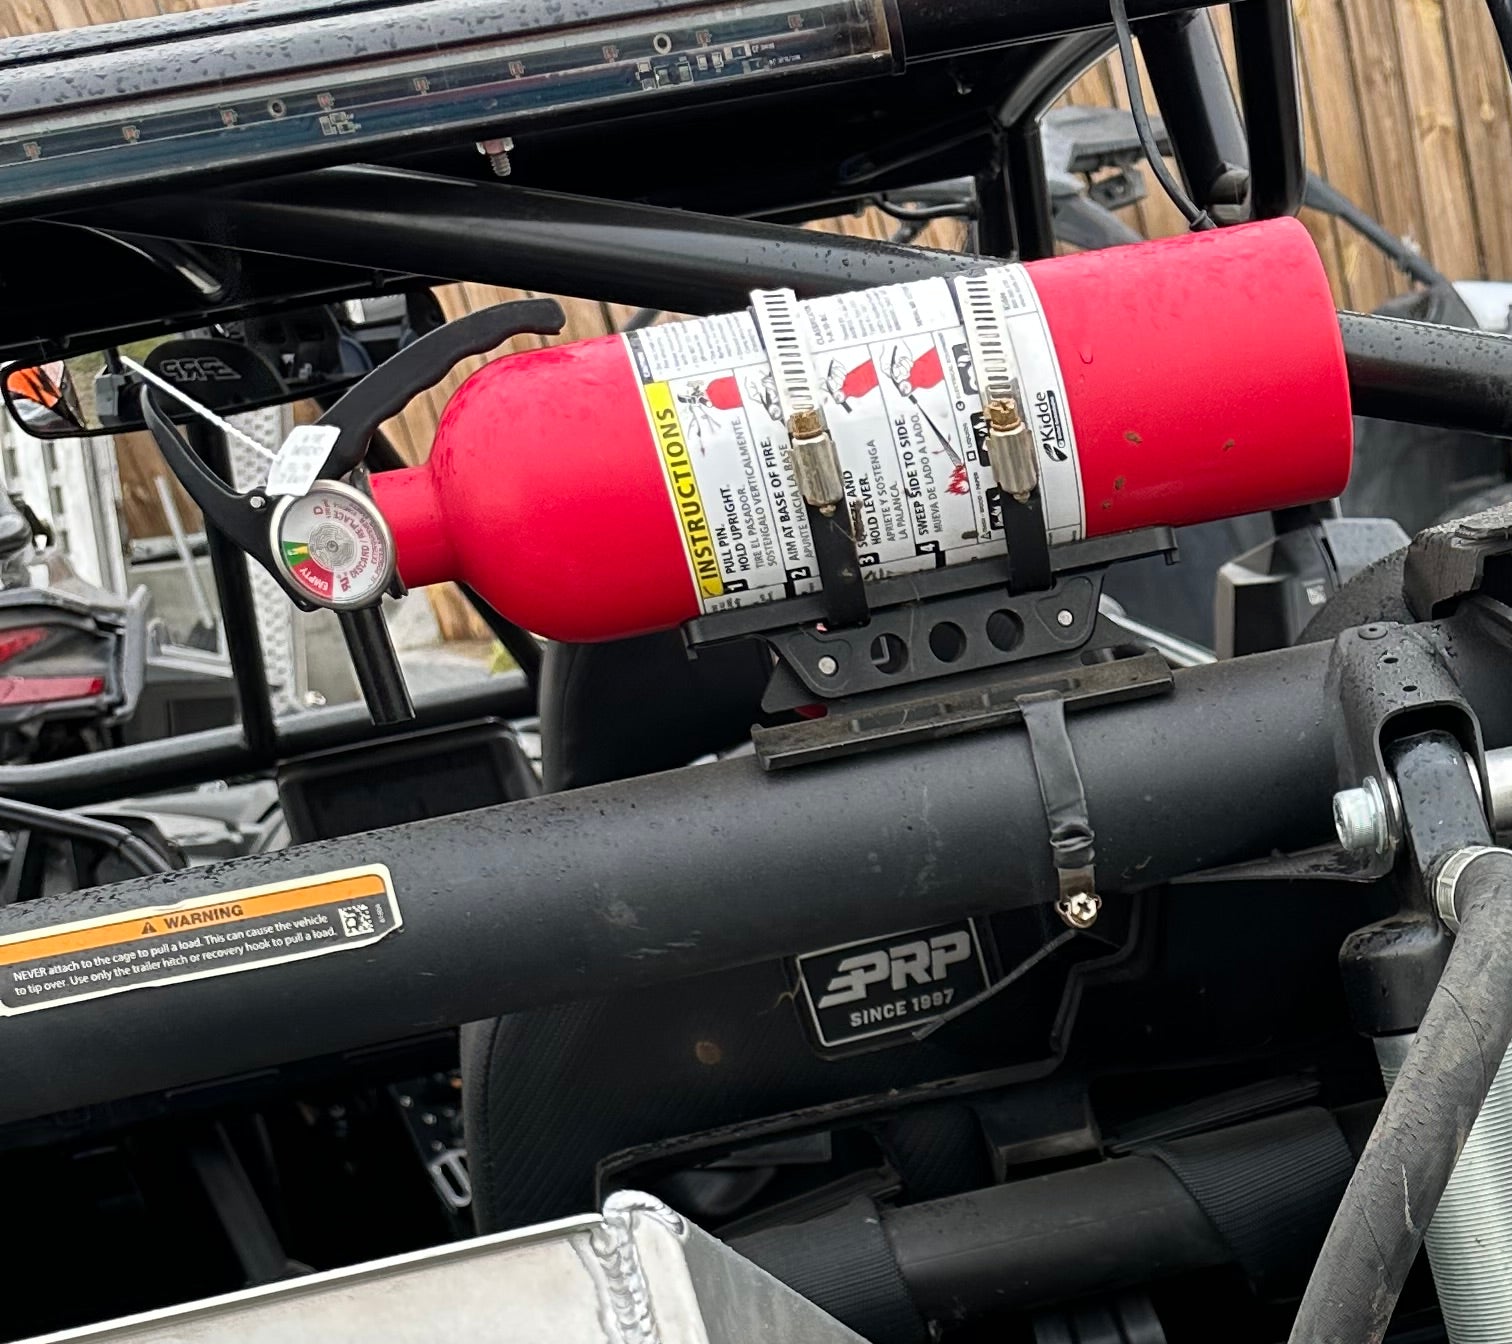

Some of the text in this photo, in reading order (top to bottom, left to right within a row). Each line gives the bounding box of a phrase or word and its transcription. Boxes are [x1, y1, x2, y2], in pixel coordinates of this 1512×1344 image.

[1033, 390, 1055, 442] Kidde
[655, 406, 718, 580] INSTRUCTIONS
[732, 415, 777, 566] SOSTENGALO VERTICALMENTE.
[761, 435, 800, 561] AIM AT BASE OF FIRE.
[780, 442, 814, 559] APUNTE HACIA LA BASE
[844, 469, 857, 498] AND
[867, 439, 896, 542] APRIETE Y SOSTENGA
[896, 414, 929, 536] SWEEP SIDE TO SIDE.
[911, 412, 944, 533] MUEVA DE LADO A LADO.
[721, 483, 751, 571] HOLD UPRIGHT.
[737, 484, 765, 568] TIRE EL PASADOR.
[859, 473, 882, 545] HOLD LEVER.
[889, 480, 908, 540] LA PALANCA.
[299, 566, 330, 591] EMPTY
[716, 523, 736, 574] PULL PIN.
[790, 567, 808, 579] 2
[859, 554, 875, 565] 3
[919, 542, 935, 553] 4
[726, 581, 743, 592] 1
[13, 967, 48, 982] NEVER
[48, 961, 81, 975] attach
[81, 960, 92, 969] to
[94, 957, 111, 966] the
[112, 951, 137, 964] cage
[137, 949, 149, 958] to
[150, 943, 170, 958] pull
[178, 938, 204, 950] load.
[204, 935, 225, 945] This
[226, 930, 244, 940] can
[245, 925, 275, 938] cause
[276, 920, 292, 932] the
[293, 913, 328, 929] vehicle
[163, 903, 244, 930] WARNING
[14, 986, 27, 996] to
[28, 982, 43, 995] tip
[68, 975, 89, 986] Use
[90, 969, 113, 983] only
[114, 966, 131, 977] the
[132, 961, 161, 974] trailer
[162, 955, 188, 968] hitch
[189, 953, 201, 962] or
[202, 944, 245, 961] recovery
[245, 939, 271, 951] hook
[272, 938, 283, 947] to
[284, 933, 304, 947] pull
[313, 927, 337, 939] load.
[819, 930, 971, 1008] PRP
[850, 988, 954, 1028] SINCE 1997
